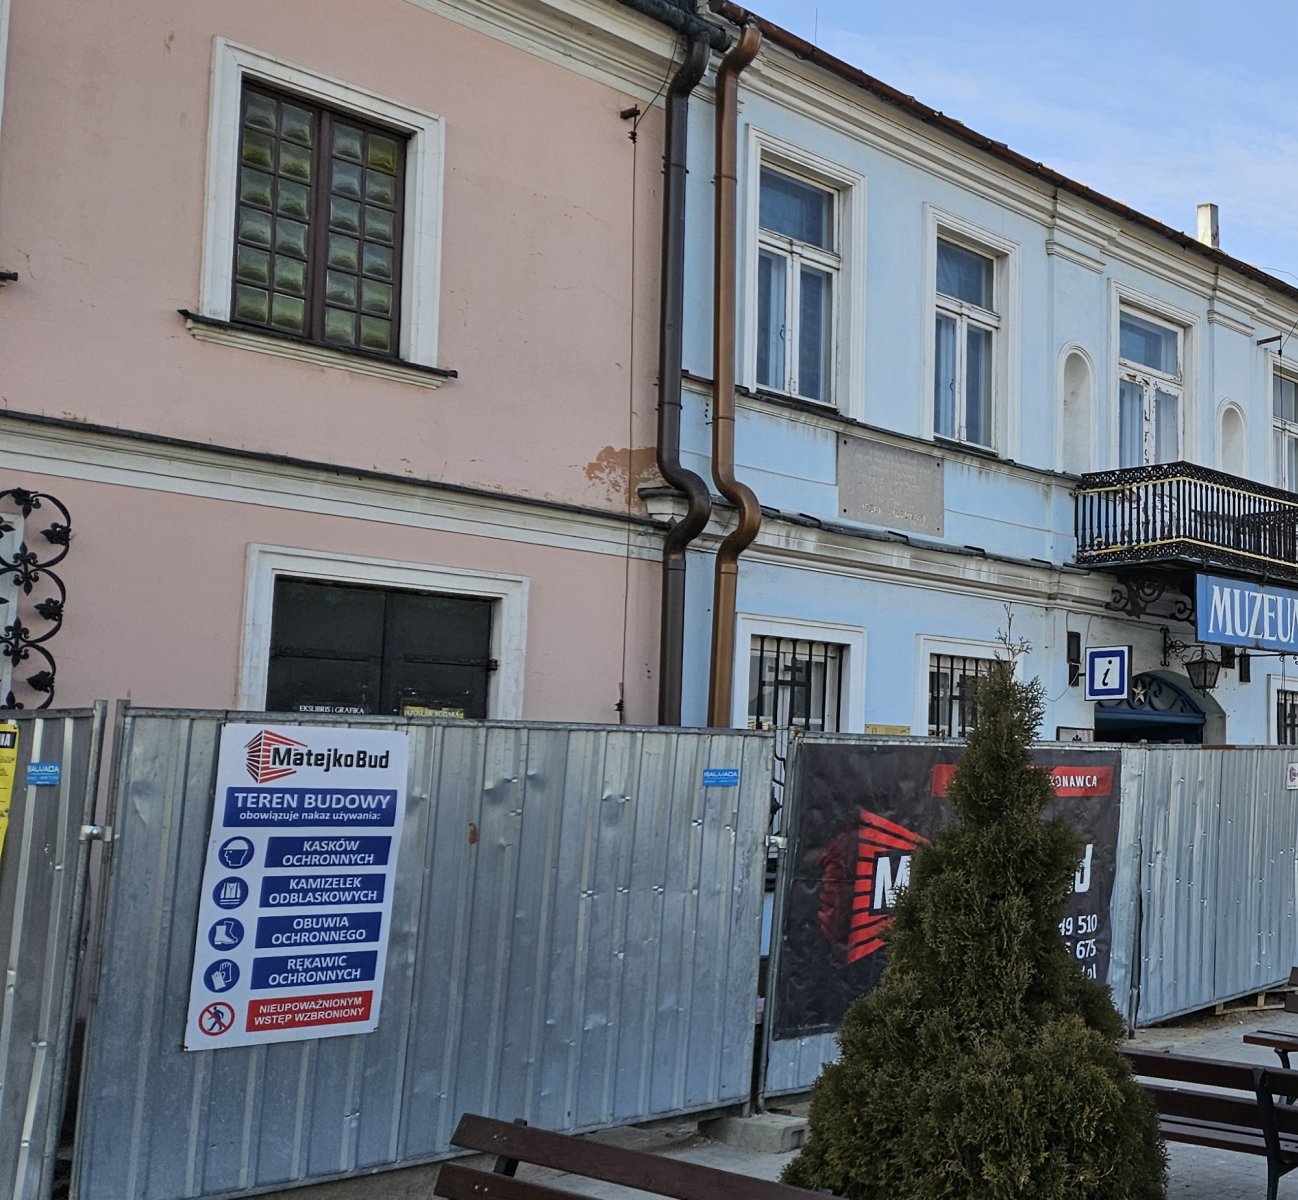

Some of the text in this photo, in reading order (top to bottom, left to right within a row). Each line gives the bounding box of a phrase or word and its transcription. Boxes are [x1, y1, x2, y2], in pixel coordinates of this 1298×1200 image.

[334, 706, 364, 714] GRAFIKA
[271, 747, 390, 772] MatejkoBud
[234, 792, 391, 809] TEREN BUDOWY
[239, 810, 381, 822] obowiązuje nakaz używania:
[303, 838, 360, 852] KASKÓW
[282, 853, 375, 866] OCHRONNYCH
[289, 877, 362, 890] KAMIZELEK
[268, 890, 377, 905] ODBLASKOWYCH
[292, 916, 349, 930] OBUWIA
[1077, 914, 1098, 934] 510
[271, 929, 366, 945] OCHRONNEGO
[1076, 939, 1096, 959] 675
[287, 955, 347, 971] RĘKAWIC
[268, 968, 361, 986] OCHRONNYCH
[259, 997, 362, 1014] NIEUPOWAŻNIONYM
[254, 1007, 364, 1026] WSTĘP WZBRONIONY
